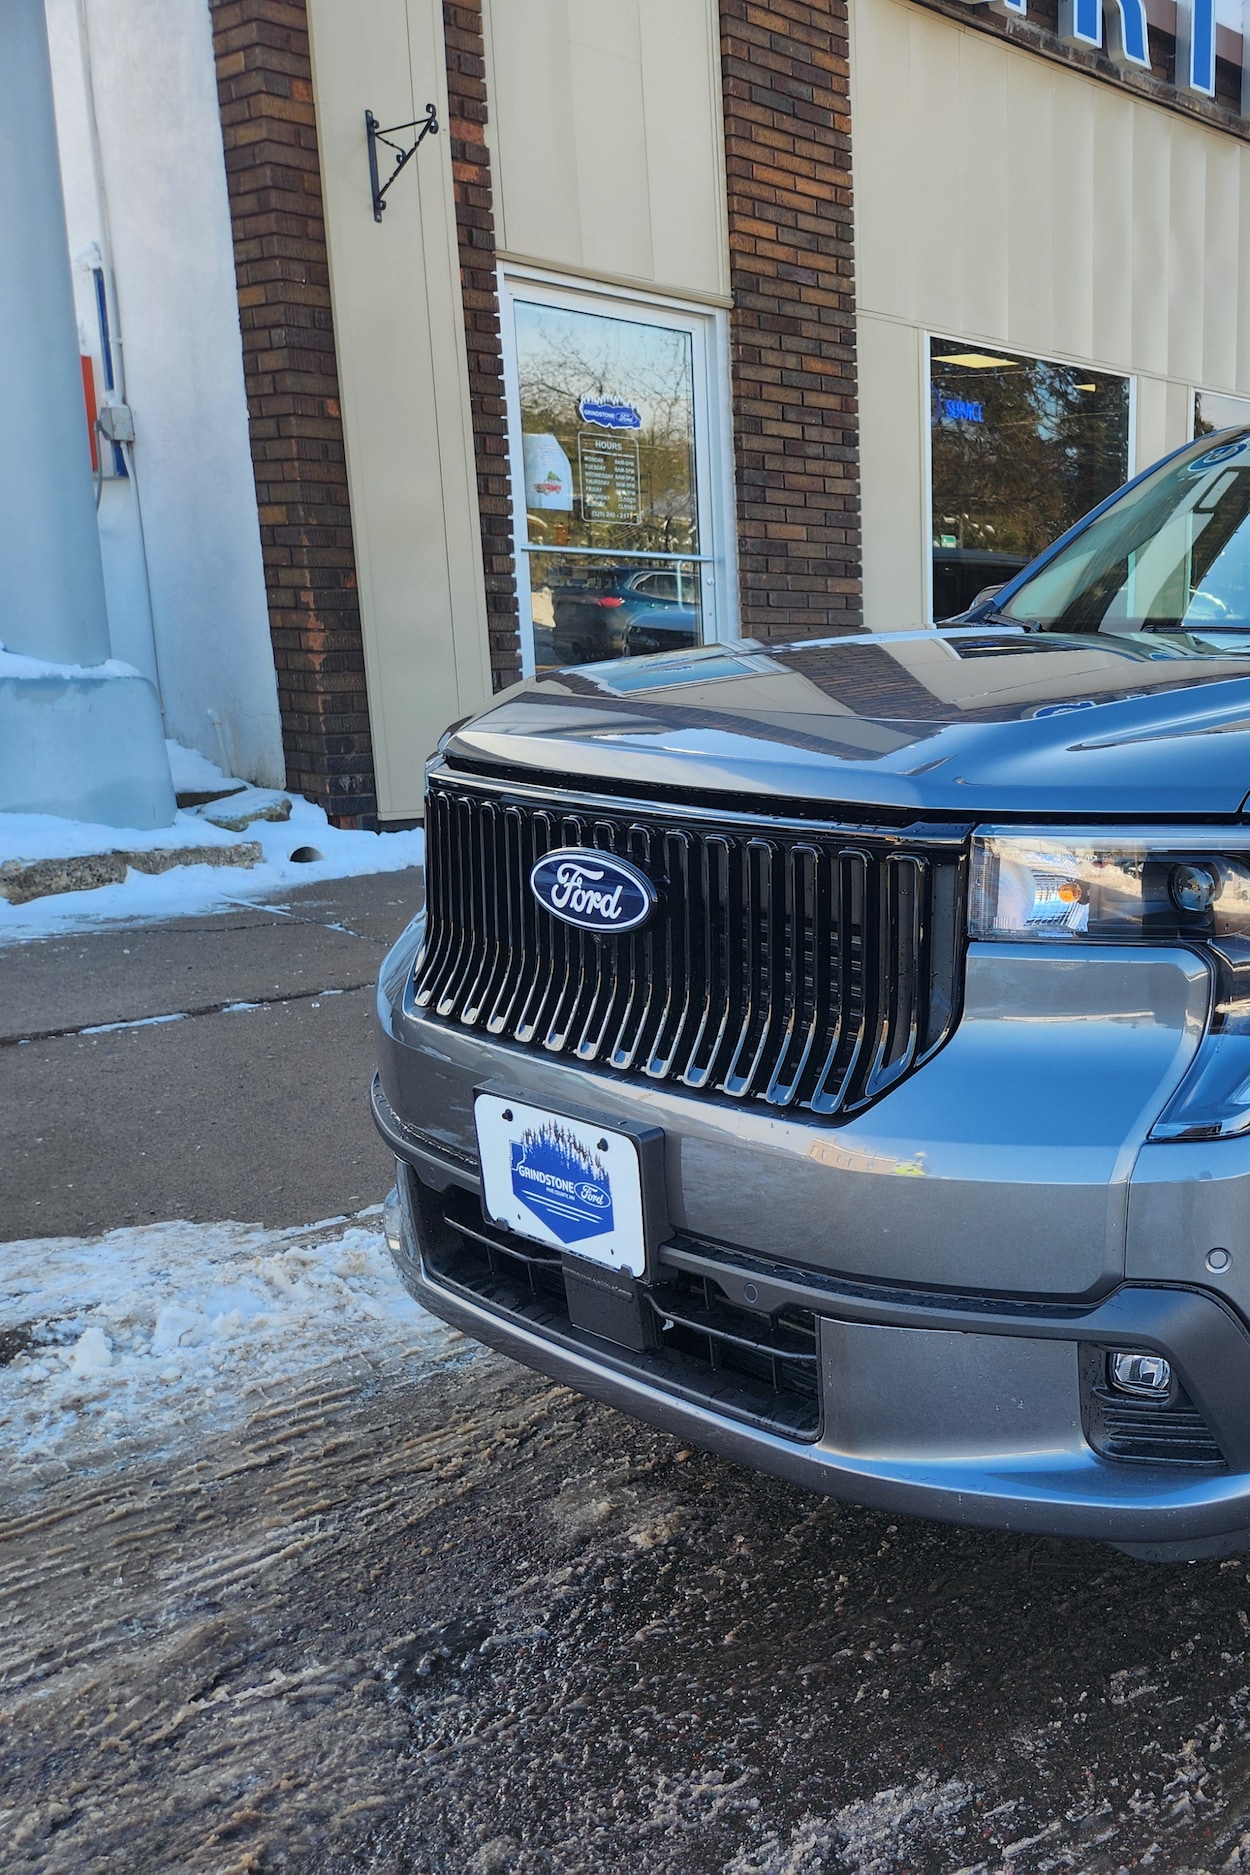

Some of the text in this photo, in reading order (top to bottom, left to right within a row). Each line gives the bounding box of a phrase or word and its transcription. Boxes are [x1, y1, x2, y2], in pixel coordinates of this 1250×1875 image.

[945, 399, 984, 423] SERVICE
[595, 440, 623, 451] HOURS
[584, 455, 604, 463] MONDAY
[585, 463, 606, 471] TUESDAY
[585, 471, 613, 479] WEDNESDAY
[586, 478, 610, 486] THURSDAY
[550, 861, 623, 920] Ford
[518, 1165, 604, 1205] GRINDSTONE Ford
